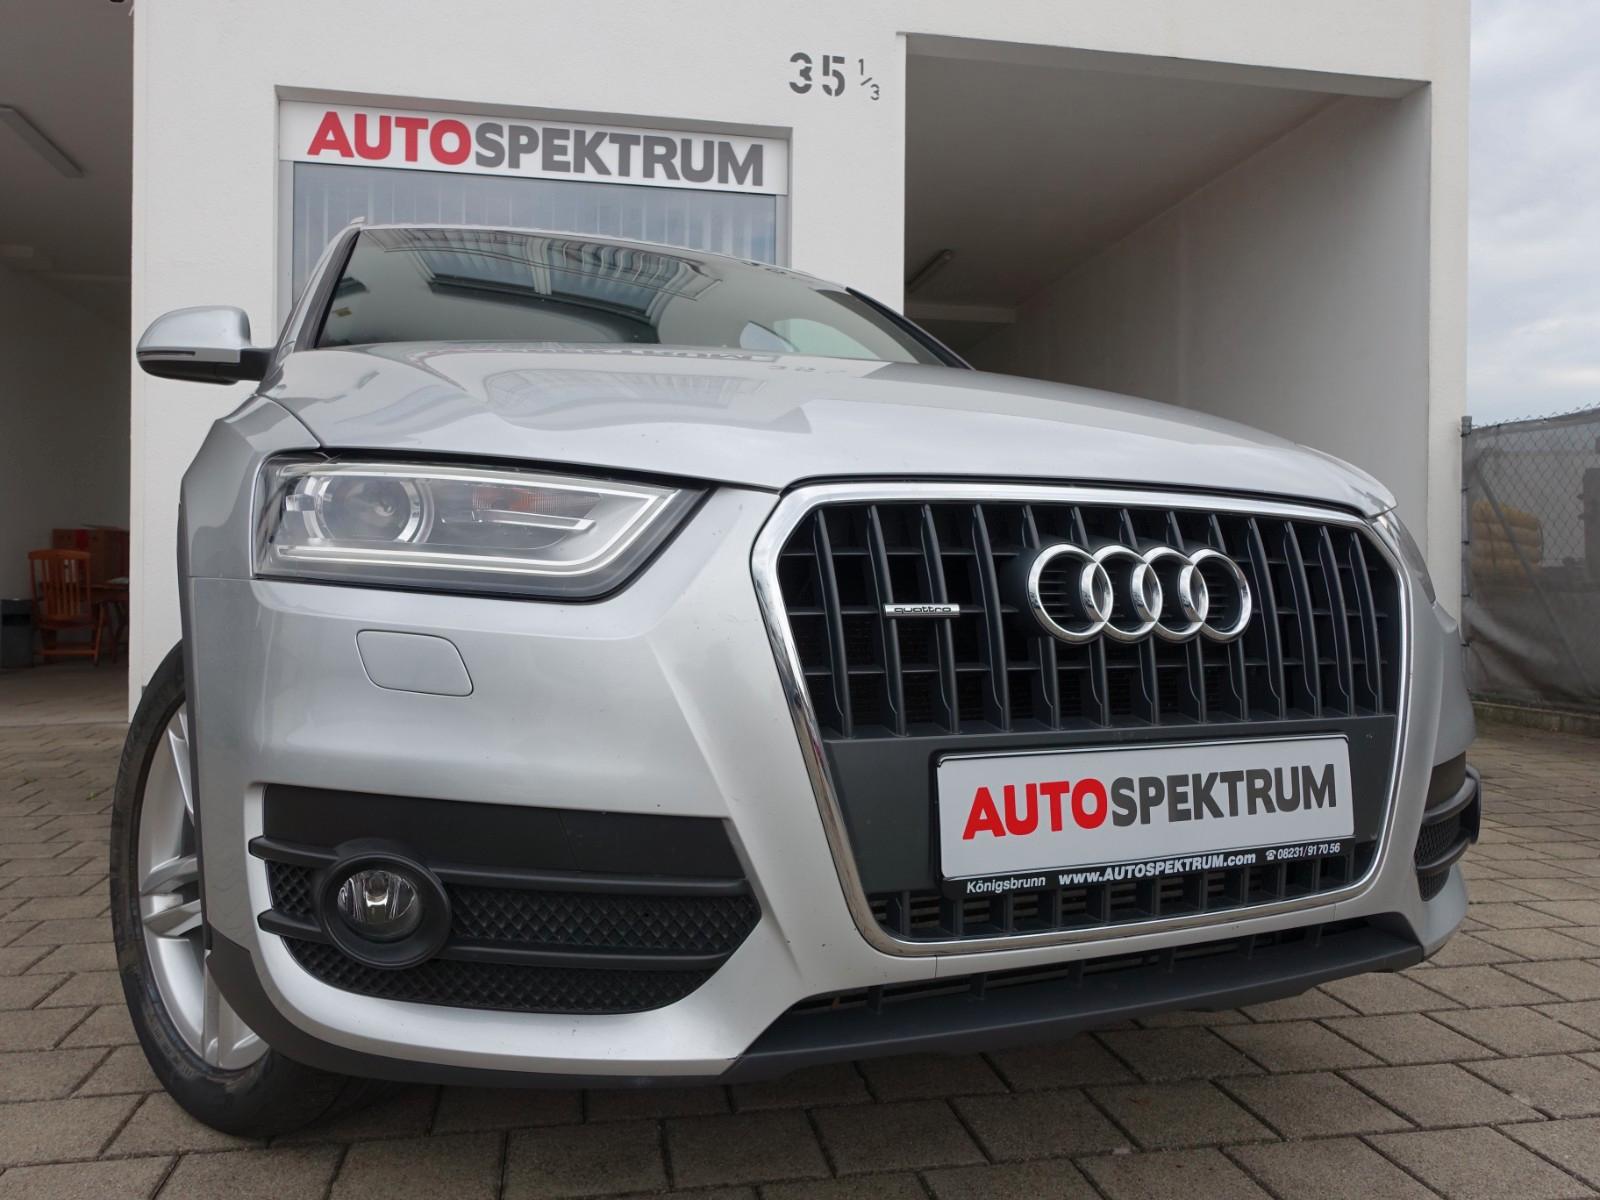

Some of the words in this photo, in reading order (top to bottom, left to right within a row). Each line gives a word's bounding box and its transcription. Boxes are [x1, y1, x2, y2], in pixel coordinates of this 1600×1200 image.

[789, 52, 845, 97] 35
[307, 111, 763, 195] AUTOSPEKTRUM
[894, 606, 952, 614] quattro
[962, 763, 1337, 840] AUTOSPEKTRUM
[966, 876, 1046, 894] Königsbrunn
[1058, 852, 1256, 885] www.AUTOSPEKTRUM.com
